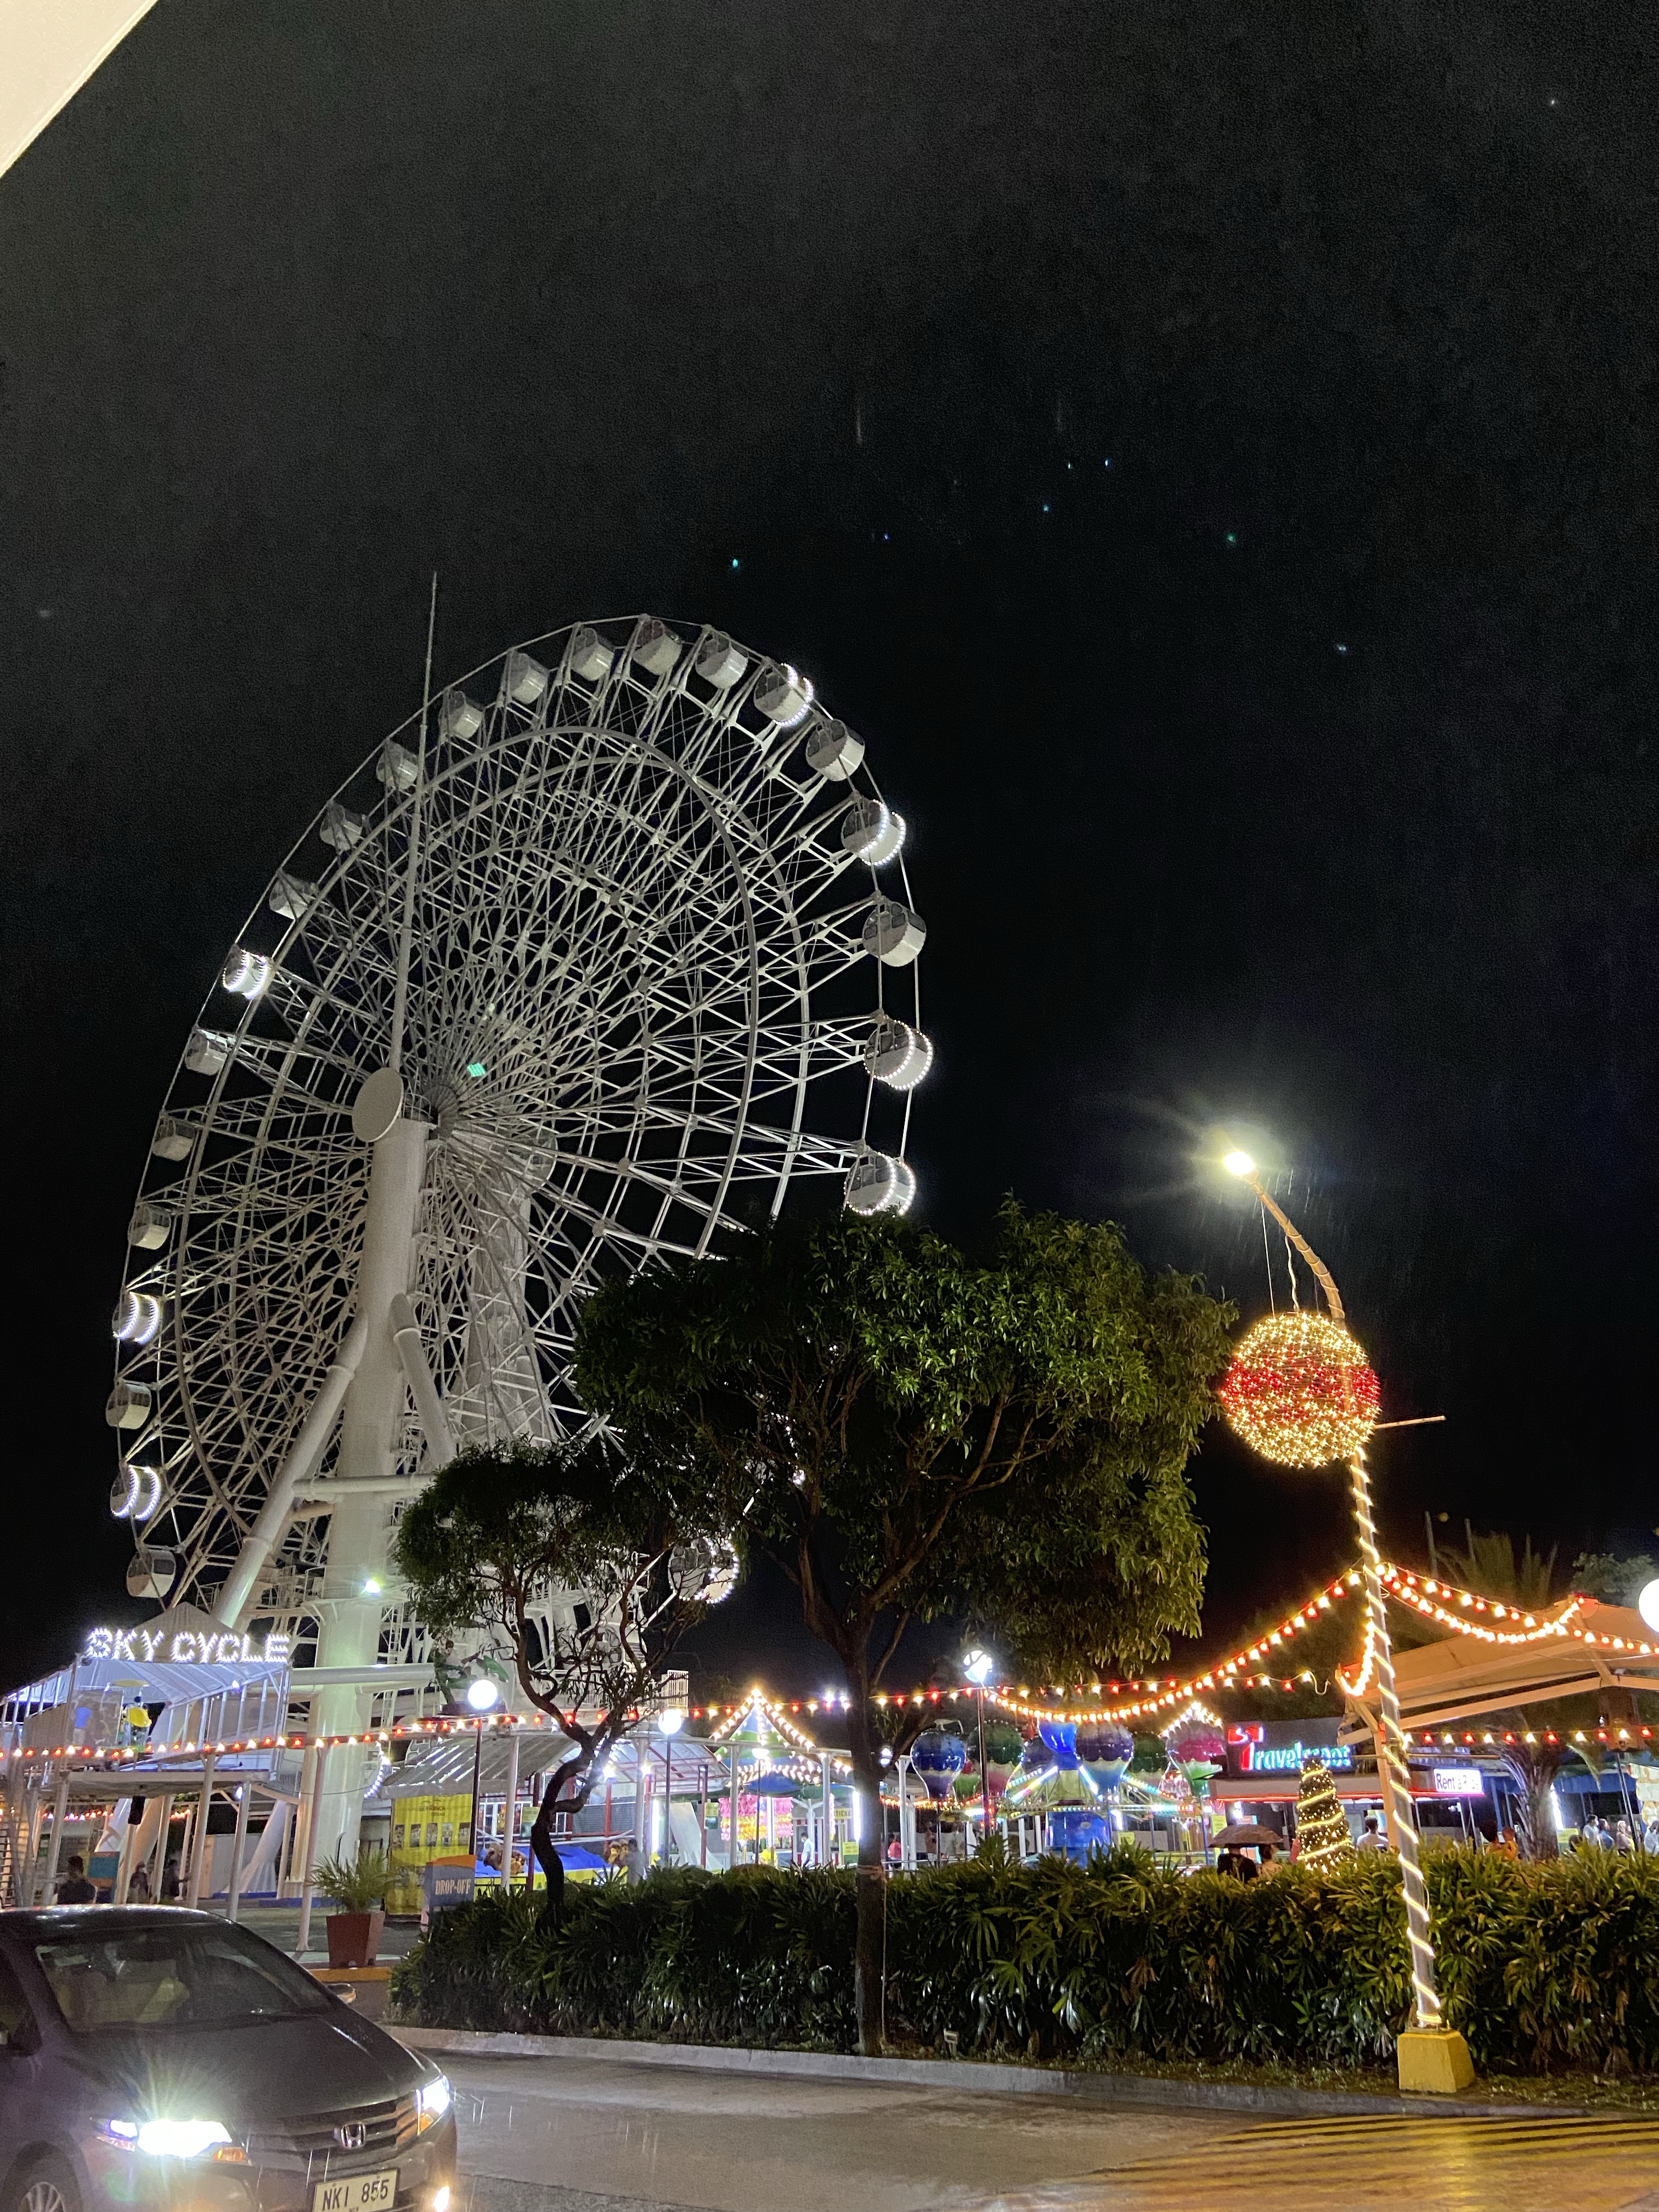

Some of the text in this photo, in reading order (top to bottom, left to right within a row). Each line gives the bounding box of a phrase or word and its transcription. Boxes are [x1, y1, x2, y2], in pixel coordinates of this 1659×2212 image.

[87, 1627, 290, 1664] SKY CYCLE
[1436, 1773, 1455, 1790] Rent
[435, 1878, 471, 1895] DROP-OFF
[322, 2179, 389, 2211] NKI 855
